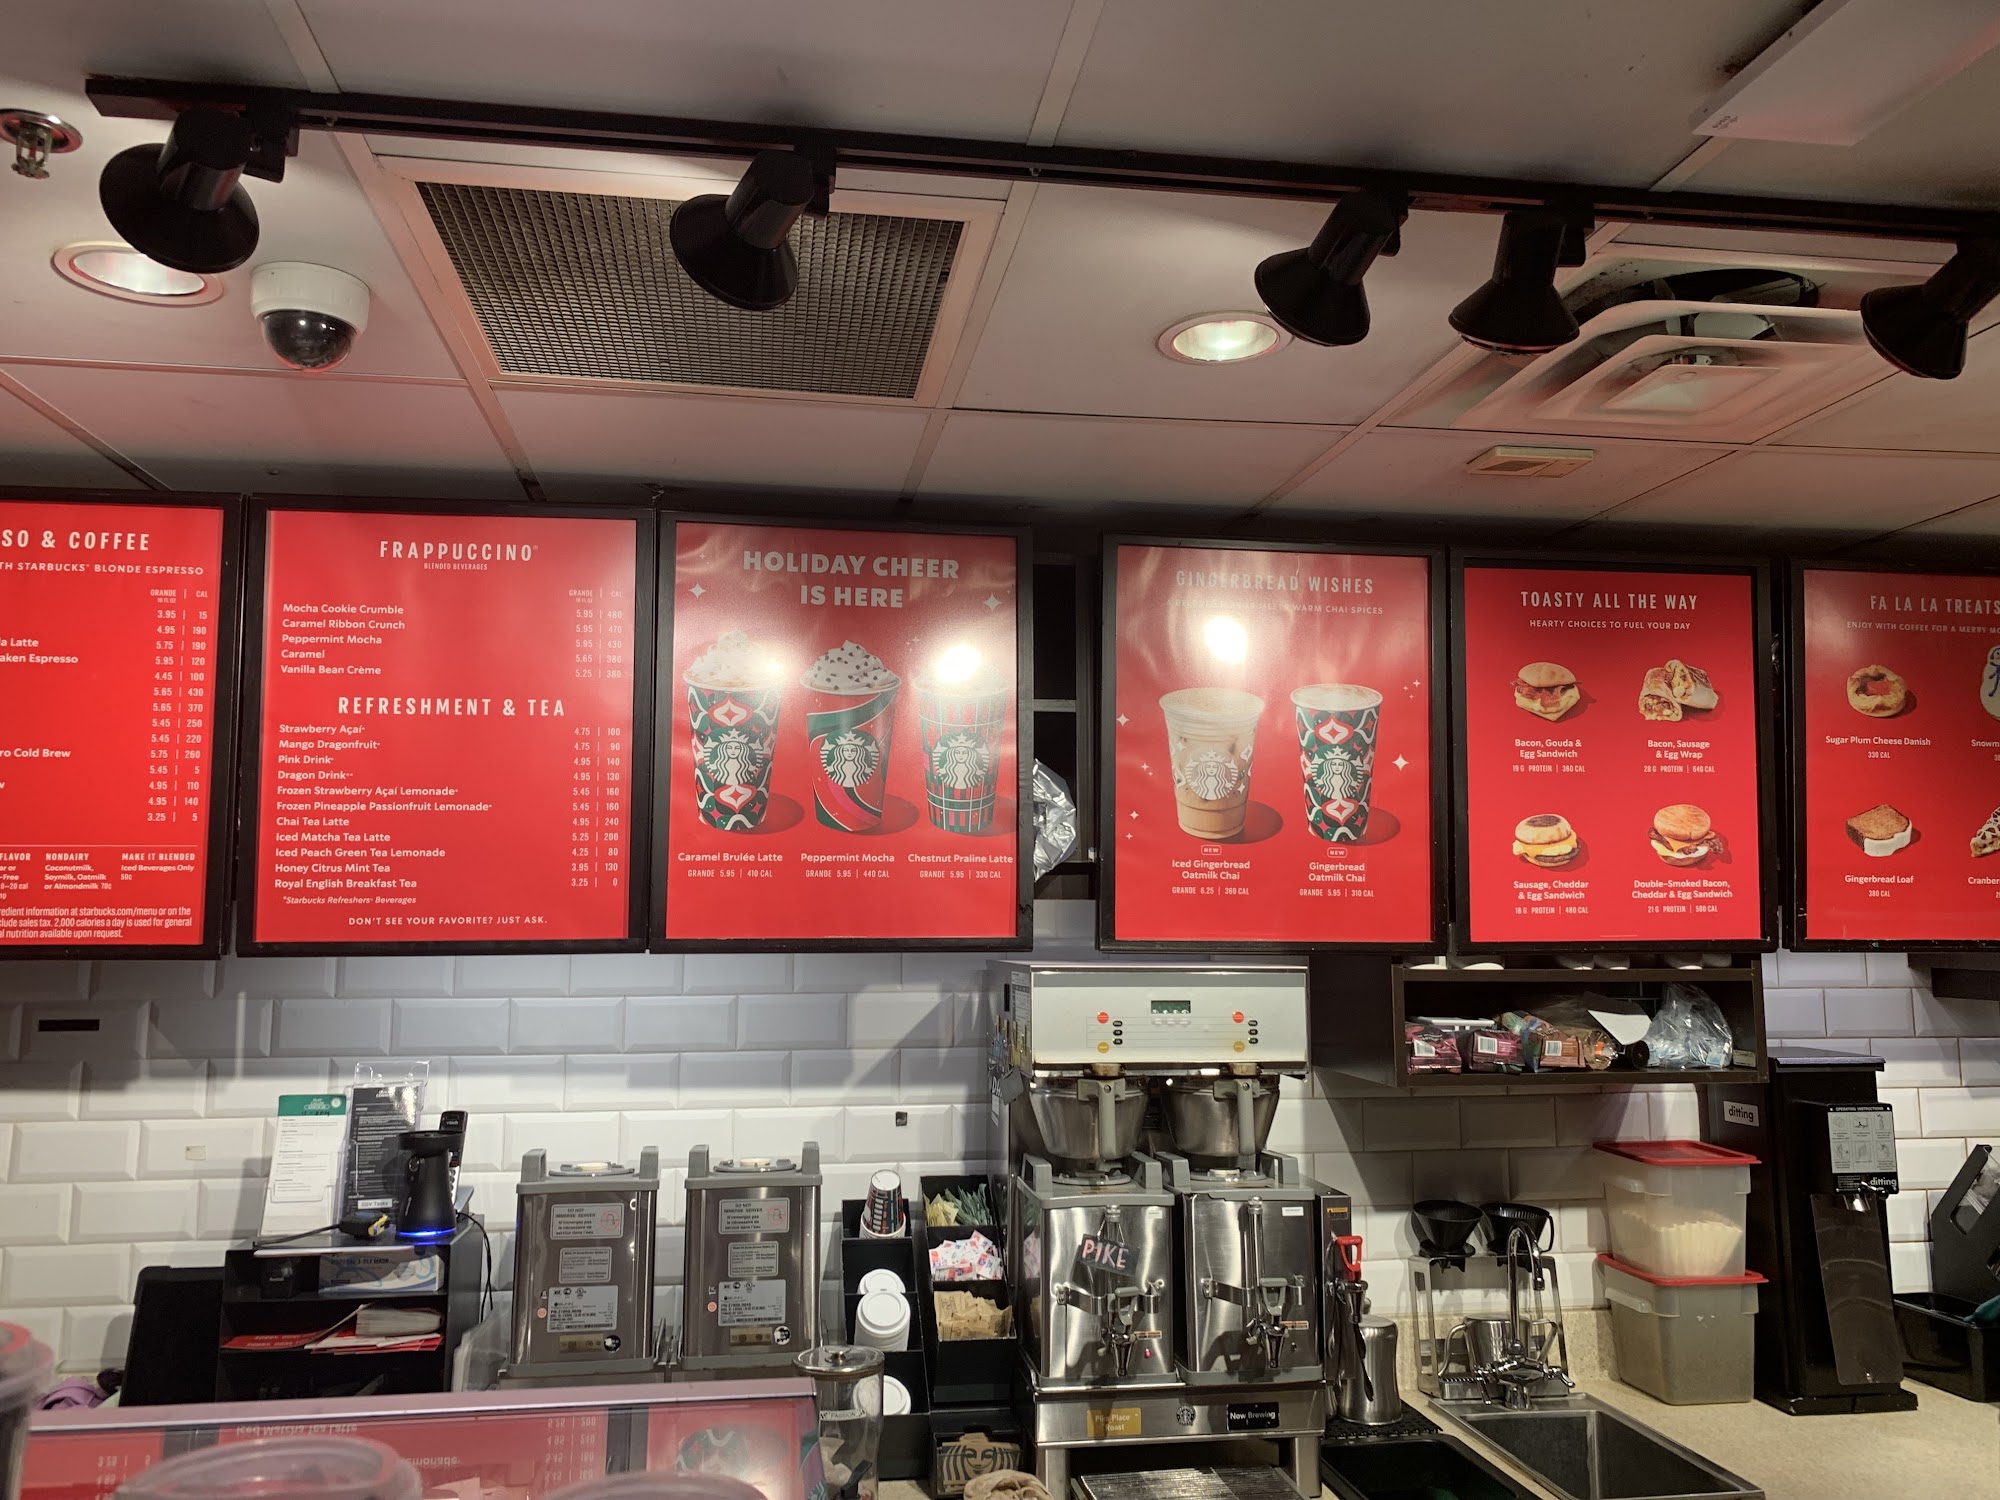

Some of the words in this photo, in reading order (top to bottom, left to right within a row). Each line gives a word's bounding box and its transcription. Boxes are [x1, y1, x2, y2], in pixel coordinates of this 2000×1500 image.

[41, 530, 55, 548] &
[68, 531, 149, 550] COFFEE
[94, 564, 141, 573] BLONDE
[145, 565, 203, 575] ESPRESSO
[743, 551, 866, 575] HOLIDAY
[872, 557, 960, 579] CHEER
[1176, 571, 1299, 591] GINGERBREAD
[1308, 577, 1374, 594] WISHES
[800, 585, 826, 605] IS
[834, 586, 903, 608] HERE
[1520, 591, 1584, 607] TOASTY
[1592, 593, 1620, 608] ALL
[1627, 593, 1656, 608] THE
[1664, 594, 1697, 609] WAY
[282, 603, 318, 612] Mocha
[320, 604, 357, 613] Cookie
[359, 604, 404, 614] Crumble
[1325, 605, 1348, 613] CHAI
[1350, 606, 1383, 614] SPICES
[1870, 595, 1887, 610] FA
[1895, 596, 1912, 611] LA
[1920, 597, 1937, 612] LA
[1945, 598, 2000, 614] TREATS
[157, 609, 176, 618] 3.95
[198, 611, 208, 619] 15
[282, 618, 326, 628] Caramel
[328, 619, 366, 628] Ribbon
[368, 620, 405, 629] Crunch
[1529, 619, 1564, 627] HEARTY
[1567, 620, 1606, 628] CHOICES
[156, 625, 176, 634] 4.95
[192, 626, 206, 635] 190
[10, 638, 39, 646] Latte
[282, 634, 344, 644] Peppermint
[346, 635, 382, 644] Mocha
[28, 653, 78, 664] Espresso
[280, 649, 325, 658] Caramel
[280, 664, 316, 673] Vanilla
[318, 664, 344, 674] Bean
[346, 665, 381, 674] Crème
[575, 668, 592, 677] 5.25
[338, 696, 491, 715] REFRESHMENT
[502, 698, 515, 715] &
[527, 699, 564, 716] TEA
[1514, 738, 1544, 747] Bacon,
[1544, 738, 1574, 747] Gouda
[1574, 739, 1582, 747] &
[1648, 741, 1675, 750] Bacon,
[1676, 739, 1710, 749] Sausage
[1825, 735, 1849, 745] Sugar
[1850, 736, 1871, 744] Plum
[1872, 736, 1902, 744] Cheese
[1903, 737, 1931, 745] Danish
[13, 748, 40, 757] Cold
[42, 748, 71, 757] Brew
[1519, 749, 1535, 759] Egg
[1536, 749, 1578, 757] Sandwich
[1655, 750, 1662, 758] &
[1664, 750, 1679, 760] Egg
[1679, 748, 1703, 759] Wrap
[276, 816, 300, 825] Chai
[302, 816, 320, 826] Tea
[322, 817, 350, 826] Latte
[572, 817, 590, 826] 4.95
[604, 817, 619, 825] 240
[276, 832, 298, 841] Iced
[300, 832, 340, 841] Matcha
[342, 832, 361, 841] Tea
[363, 833, 390, 841] Latte
[571, 832, 589, 841] 5.25
[603, 832, 619, 841] 200
[45, 852, 89, 860] NONDAIRY
[147, 852, 156, 860] IT
[677, 852, 720, 861] Caramel
[722, 852, 755, 861] Brulée
[757, 853, 783, 861] Latte
[800, 853, 860, 863] Peppermint
[861, 853, 894, 862] Mocha
[907, 853, 952, 862] Chestnut
[953, 854, 987, 862] Praline
[988, 854, 1013, 863] Latte
[275, 864, 309, 874] Honey
[311, 863, 342, 872] Citrus
[344, 863, 370, 872] Mint
[372, 863, 390, 872] Tea
[1172, 860, 1191, 868] Iced
[1193, 860, 1250, 871] Gingerbread
[1309, 863, 1365, 873] Gingerbread
[687, 869, 714, 877] GRANDE
[719, 869, 735, 877] 5.95
[746, 869, 758, 877] 410
[759, 869, 772, 877] CAL
[805, 869, 832, 877] GRANDE
[836, 869, 851, 877] 5.95
[862, 869, 876, 877] 440
[877, 869, 890, 877] CAL
[1181, 870, 1218, 879] Oatmilk
[1219, 871, 1240, 879] Chai
[1308, 872, 1344, 881] Oatmilk
[1345, 873, 1365, 882] Chai
[274, 878, 303, 890] Royal
[306, 878, 343, 890] English
[346, 878, 396, 888] Breakfast
[398, 878, 417, 887] Tea
[1844, 874, 1895, 884] Gingerbread
[1896, 875, 1914, 883] Loaf
[1513, 880, 1551, 890] Sausage,
[1552, 880, 1589, 888] Cheddar
[1634, 879, 1701, 888] Double-Smoked
[1702, 879, 1730, 890] Bacon,
[1299, 888, 1323, 896] GRANDE
[1327, 888, 1341, 896] 5.95
[1362, 889, 1374, 897] CAL
[1631, 890, 1668, 898] Cheddar
[1668, 890, 1676, 898] &
[1676, 890, 1692, 900] Egg
[1692, 889, 1733, 898] Sandwich
[25, 906, 69, 916] information
[70, 907, 78, 916] at
[78, 906, 158, 918] starbucks.com/menu
[348, 917, 381, 925] DON'T
[385, 917, 402, 925] SEE
[406, 916, 435, 924] YOUR
[438, 916, 493, 924] FAVORITE?
[1728, 1105, 1754, 1122] ditting
[1869, 1176, 1897, 1187] ditting
[1081, 1239, 1129, 1270] PIKE
[1229, 1412, 1247, 1420] Now
[1247, 1411, 1276, 1420] Brewing
